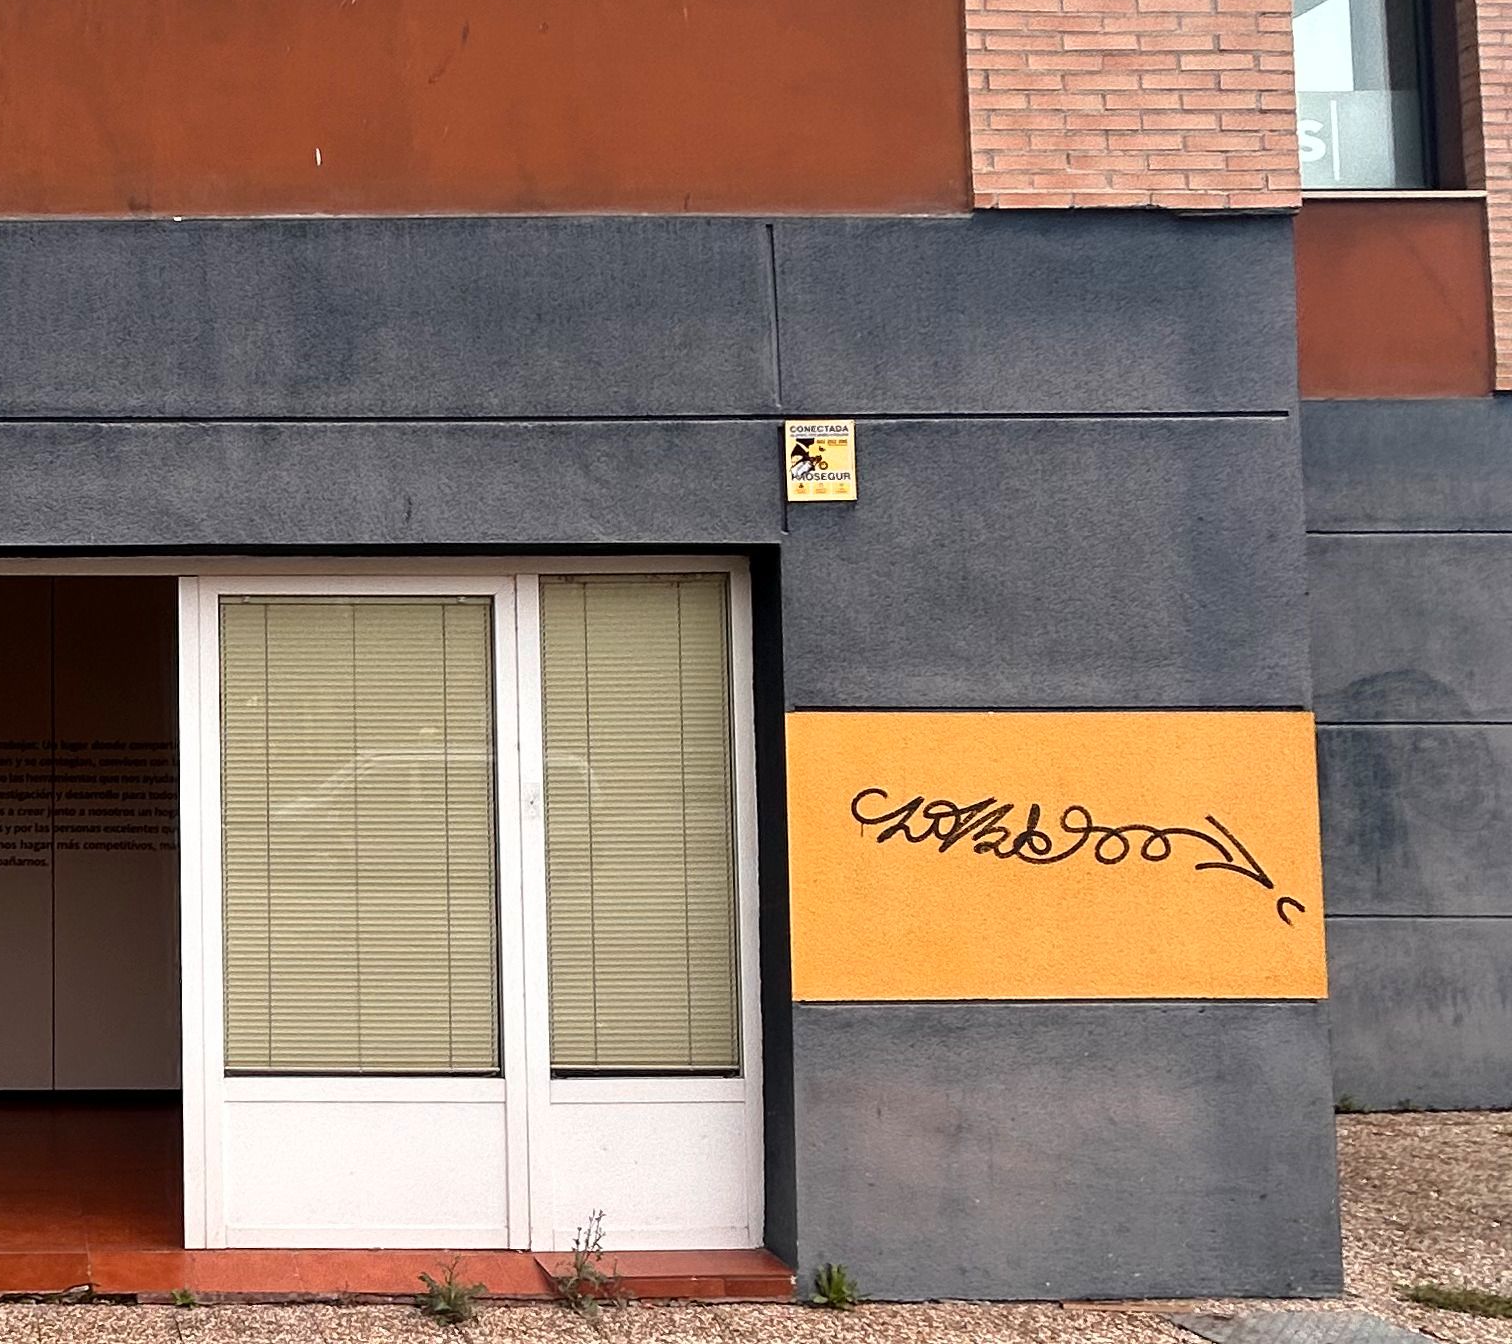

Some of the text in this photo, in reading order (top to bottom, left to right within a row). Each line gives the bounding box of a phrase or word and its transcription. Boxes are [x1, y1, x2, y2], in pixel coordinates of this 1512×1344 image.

[789, 425, 849, 433] CONECTADA
[55, 792, 63, 801] y
[122, 792, 147, 801] para
[46, 807, 76, 818] junto
[88, 808, 136, 816] nosotros
[4, 826, 12, 834] y
[13, 826, 33, 834] por
[34, 823, 50, 833] las
[53, 826, 102, 834] personas
[103, 824, 159, 833] excelentes
[20, 839, 53, 851] hagan
[56, 839, 80, 849] más
